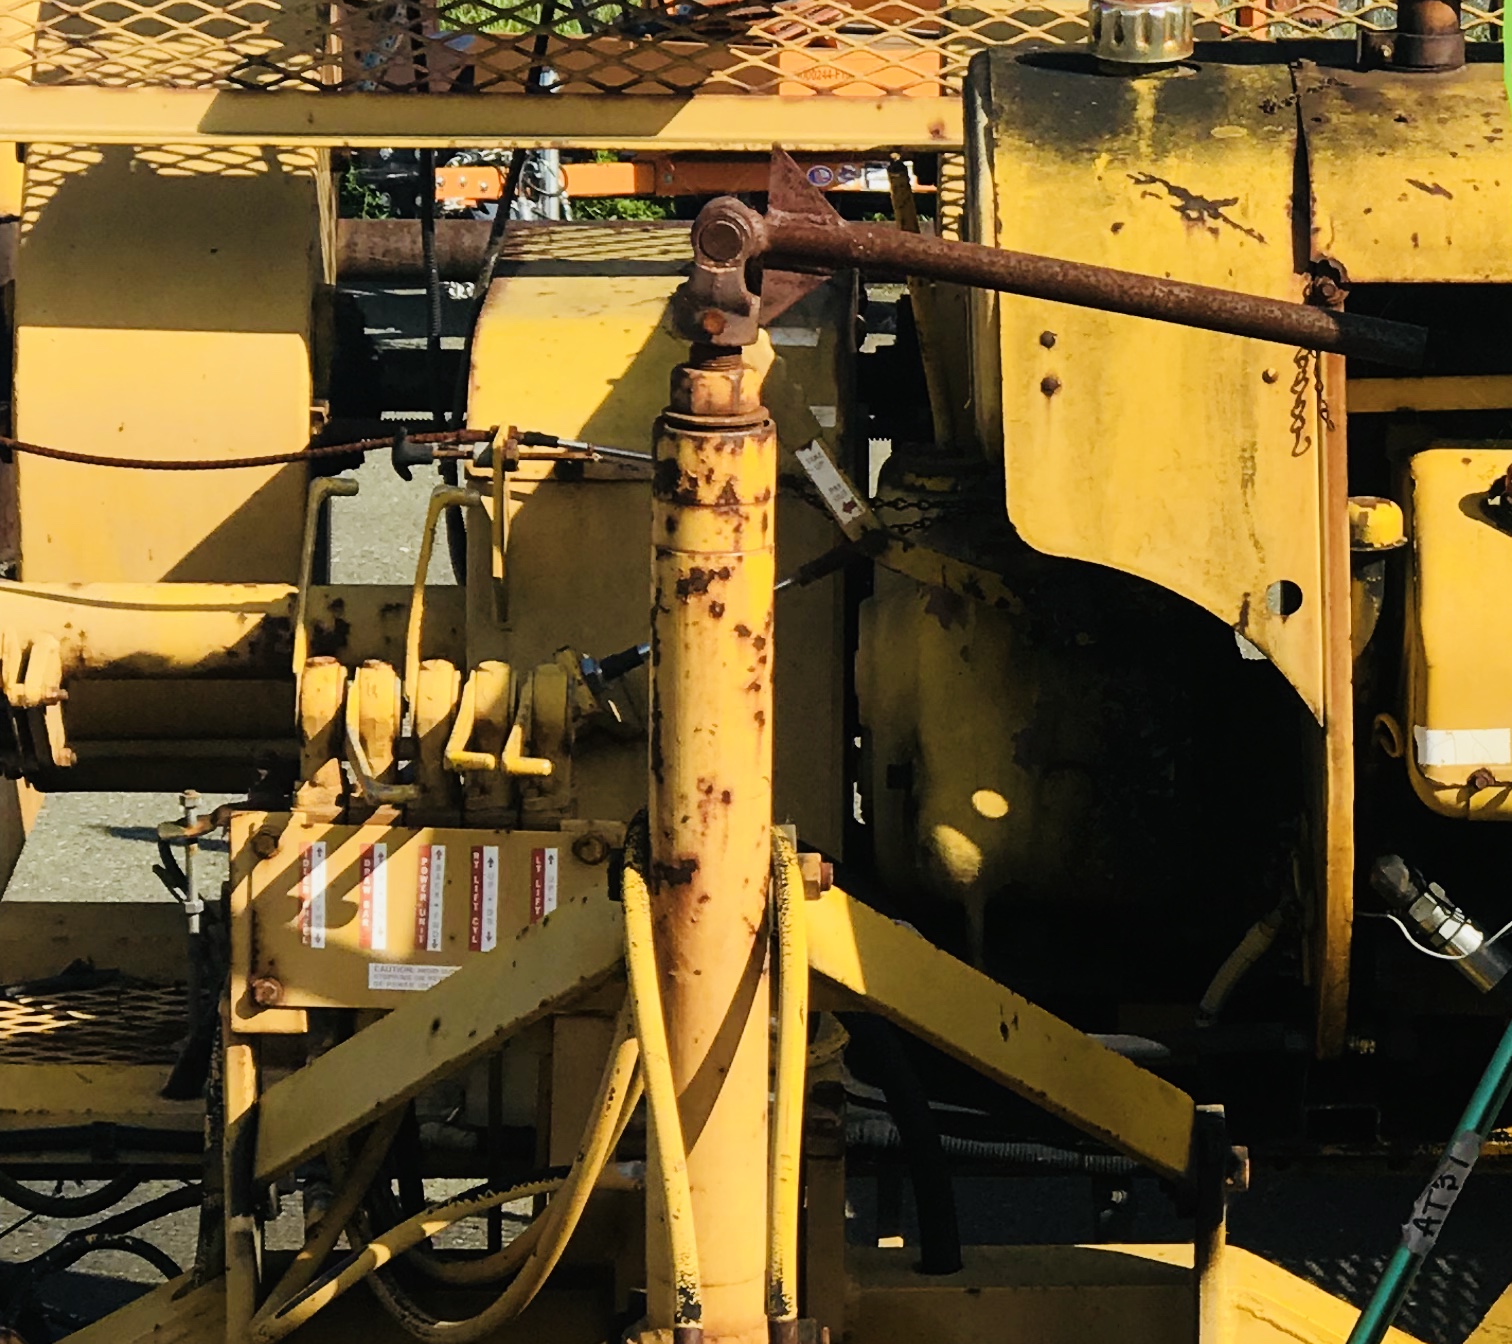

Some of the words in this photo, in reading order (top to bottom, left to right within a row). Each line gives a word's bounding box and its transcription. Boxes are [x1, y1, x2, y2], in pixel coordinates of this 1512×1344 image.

[363, 858, 371, 894] DRAW
[420, 856, 429, 903] POWER
[418, 908, 426, 945] UNIT
[471, 917, 479, 944] CYL
